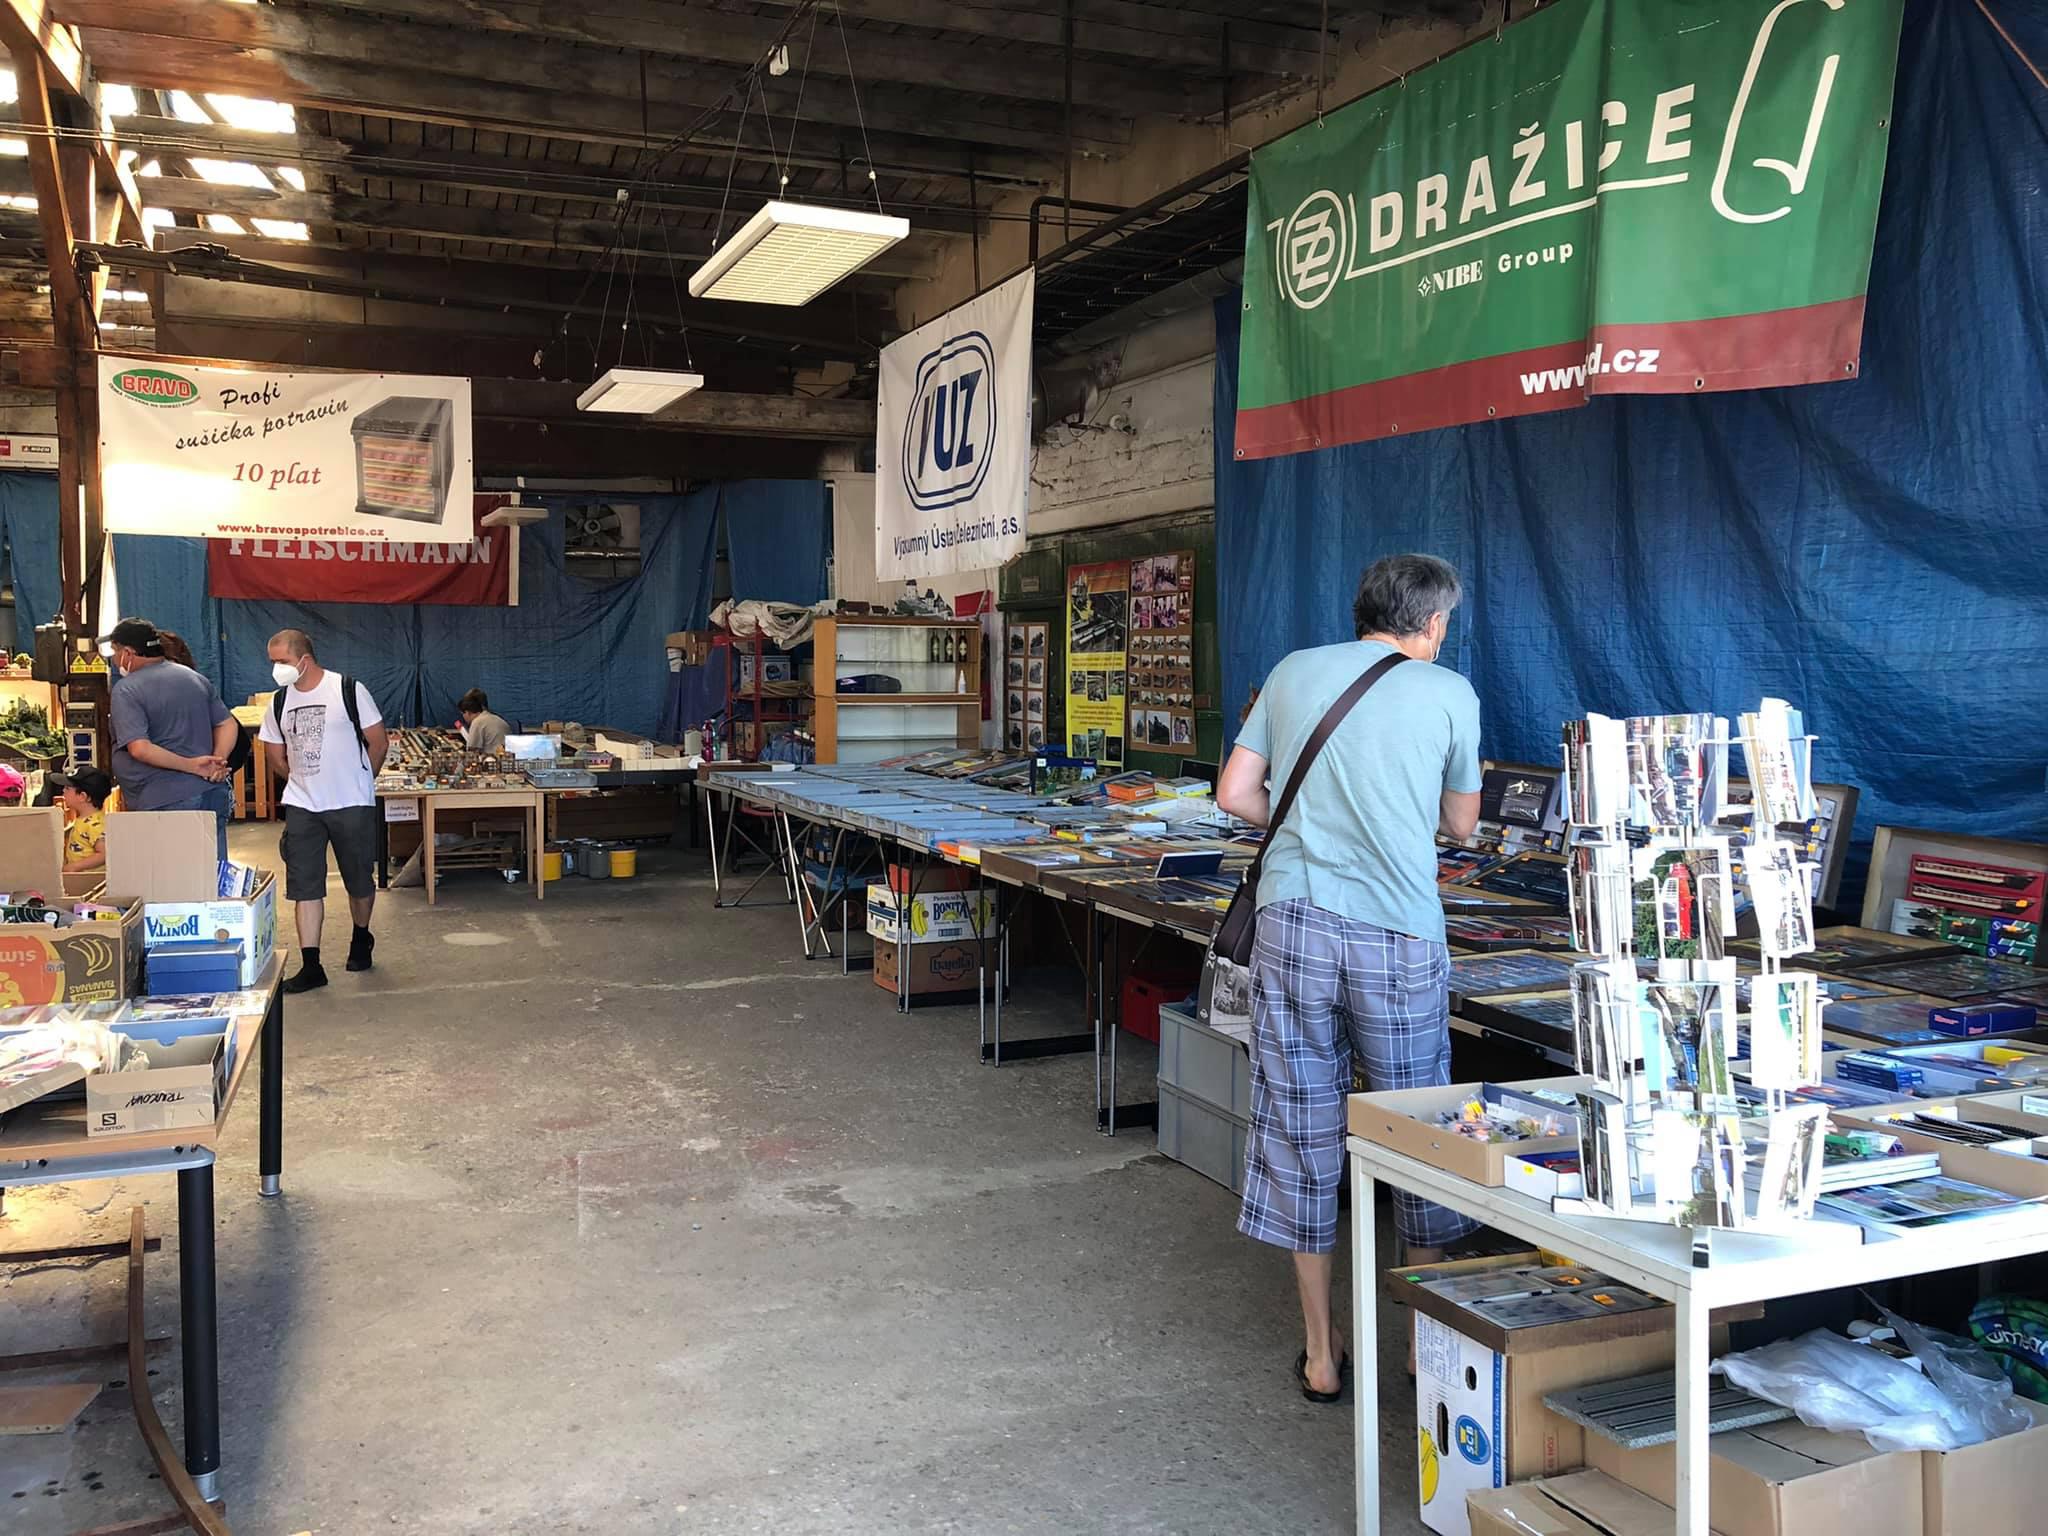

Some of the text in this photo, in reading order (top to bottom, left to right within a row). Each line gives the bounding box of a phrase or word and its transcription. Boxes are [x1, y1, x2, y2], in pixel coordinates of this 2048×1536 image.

[1370, 83, 1695, 254] DRAŽICE
[1432, 242, 1573, 294] NIBE Group
[122, 375, 191, 398] BRAVO
[219, 381, 281, 410] Profi
[175, 398, 349, 450] sušička potravin
[232, 462, 322, 491] 10 plat
[1002, 516, 1021, 536] a.s.
[229, 536, 492, 564] FLEISCHMANN
[933, 902, 968, 921] BONITA
[145, 914, 200, 938] BONITA
[69, 980, 115, 994] BANANAS
